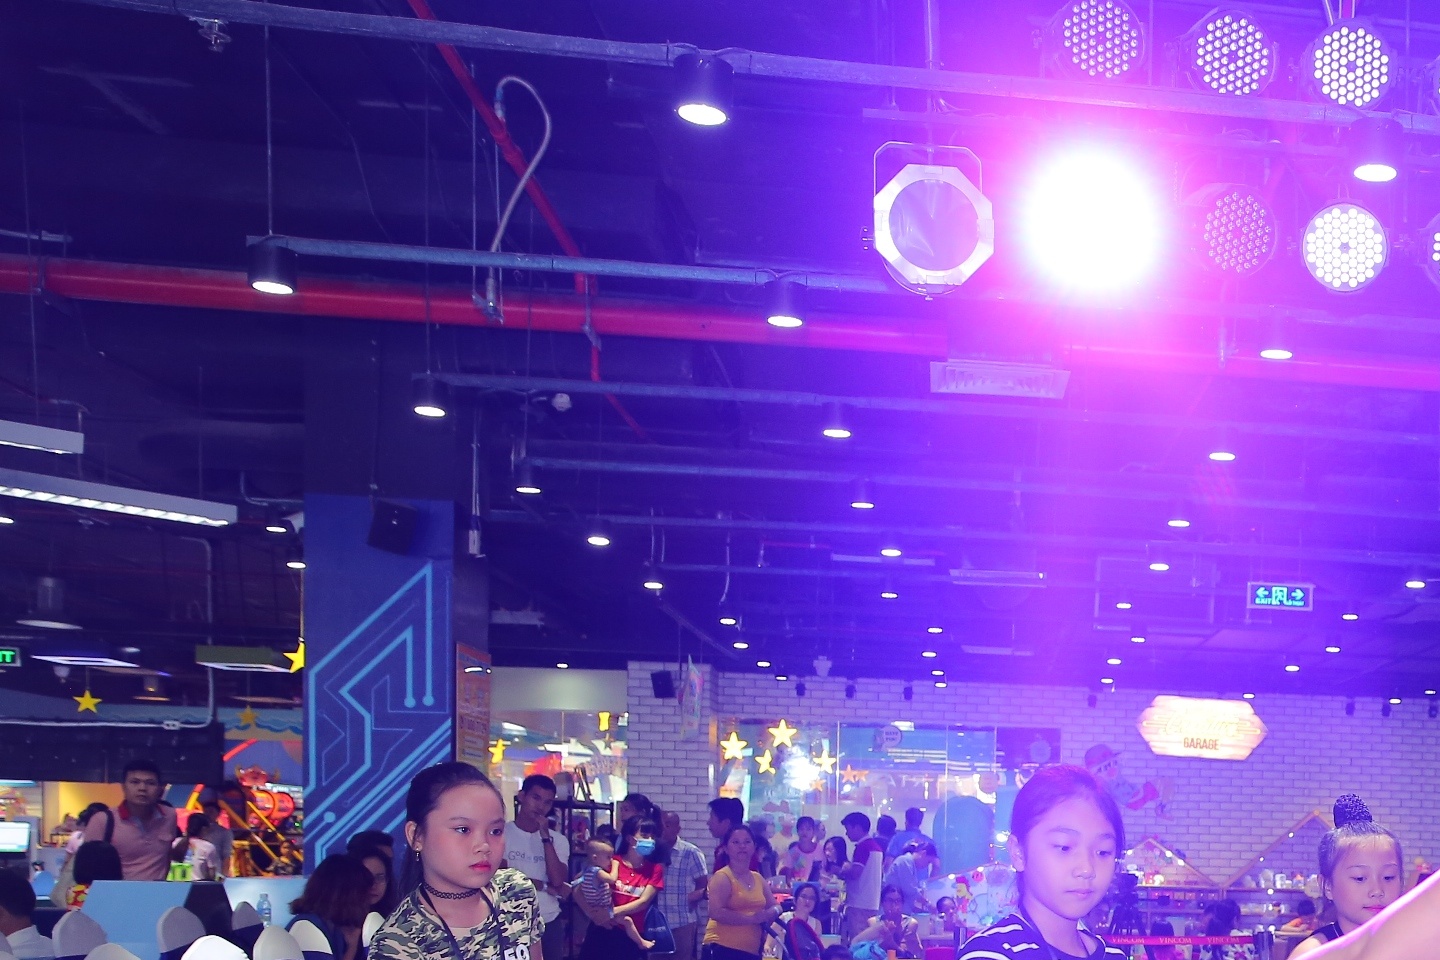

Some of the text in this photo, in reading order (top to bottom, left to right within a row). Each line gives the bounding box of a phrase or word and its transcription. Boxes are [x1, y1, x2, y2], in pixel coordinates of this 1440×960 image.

[1183, 737, 1220, 751] GARAGE
[1112, 936, 1240, 945] VINCOM VINCOM VINCOM
